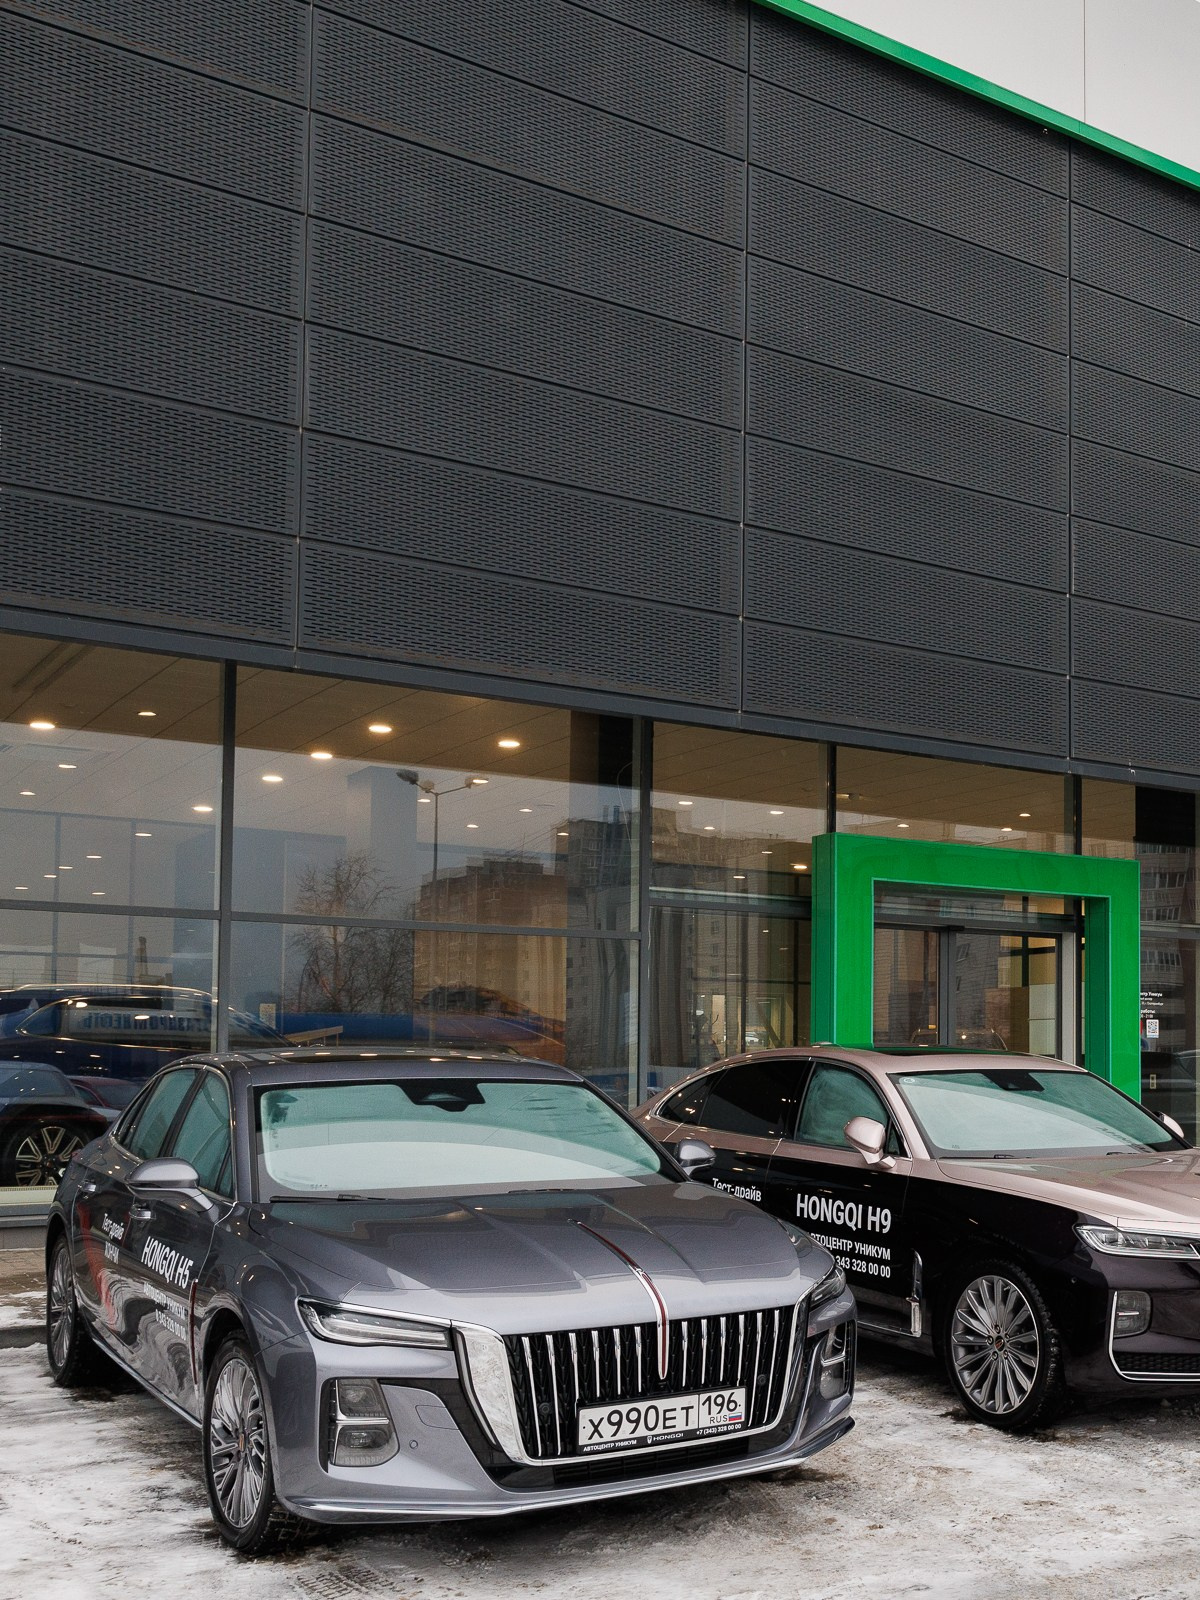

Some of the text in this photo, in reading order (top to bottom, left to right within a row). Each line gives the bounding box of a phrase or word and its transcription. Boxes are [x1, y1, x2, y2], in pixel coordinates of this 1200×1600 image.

[712, 1178, 762, 1202] Тест-драйв
[796, 1194, 892, 1234] HONGQI H9
[809, 1232, 890, 1260] ТОЦЕНТР УНИКУМ
[141, 1236, 194, 1289] HONGQI H5
[836, 1256, 891, 1278] 343 328 00 00
[587, 1392, 738, 1441] Х990ЕТ 196
[710, 1414, 728, 1424] RUS
[583, 1443, 614, 1452] АВТОЦЕНТР
[654, 1433, 684, 1441] HONGQI
